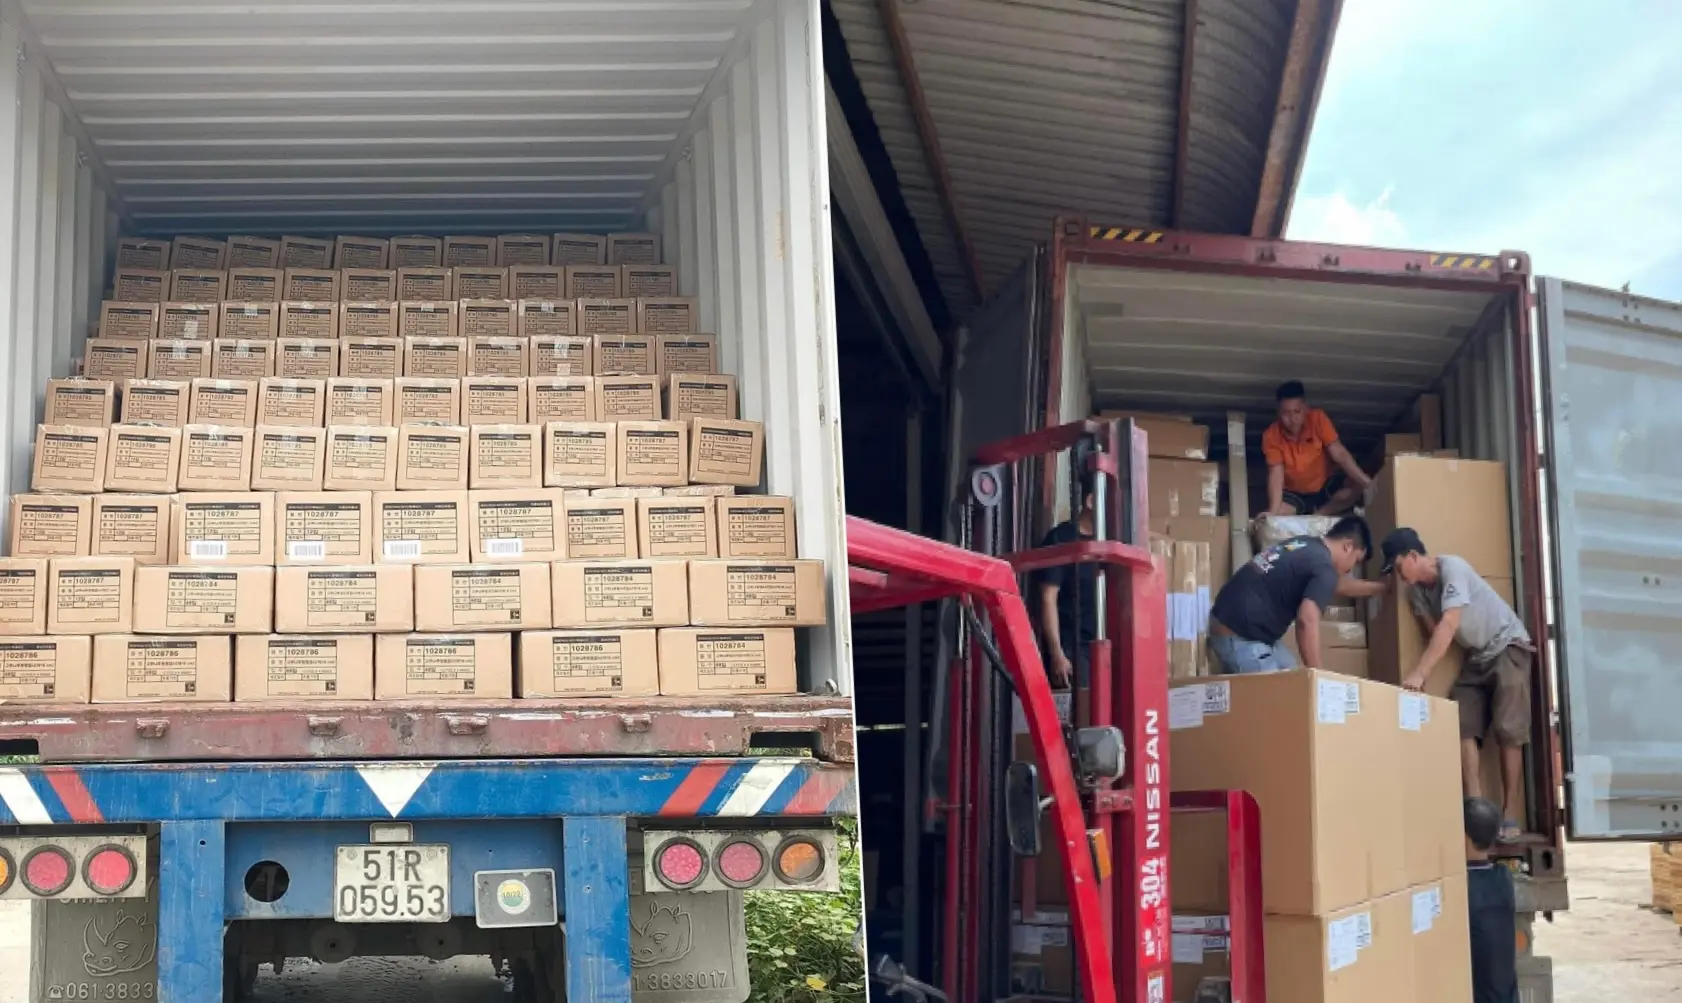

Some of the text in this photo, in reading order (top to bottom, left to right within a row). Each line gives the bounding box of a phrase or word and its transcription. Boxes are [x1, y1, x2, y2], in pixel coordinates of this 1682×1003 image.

[5, 651, 39, 659] 1028786
[286, 648, 320, 656] 1028786
[425, 647, 458, 655] 1028786
[571, 644, 604, 652] 1028786
[1145, 708, 1161, 849] NISSAN
[363, 850, 422, 882] 51R
[1140, 857, 1161, 910] 304
[340, 885, 445, 917] 059.53
